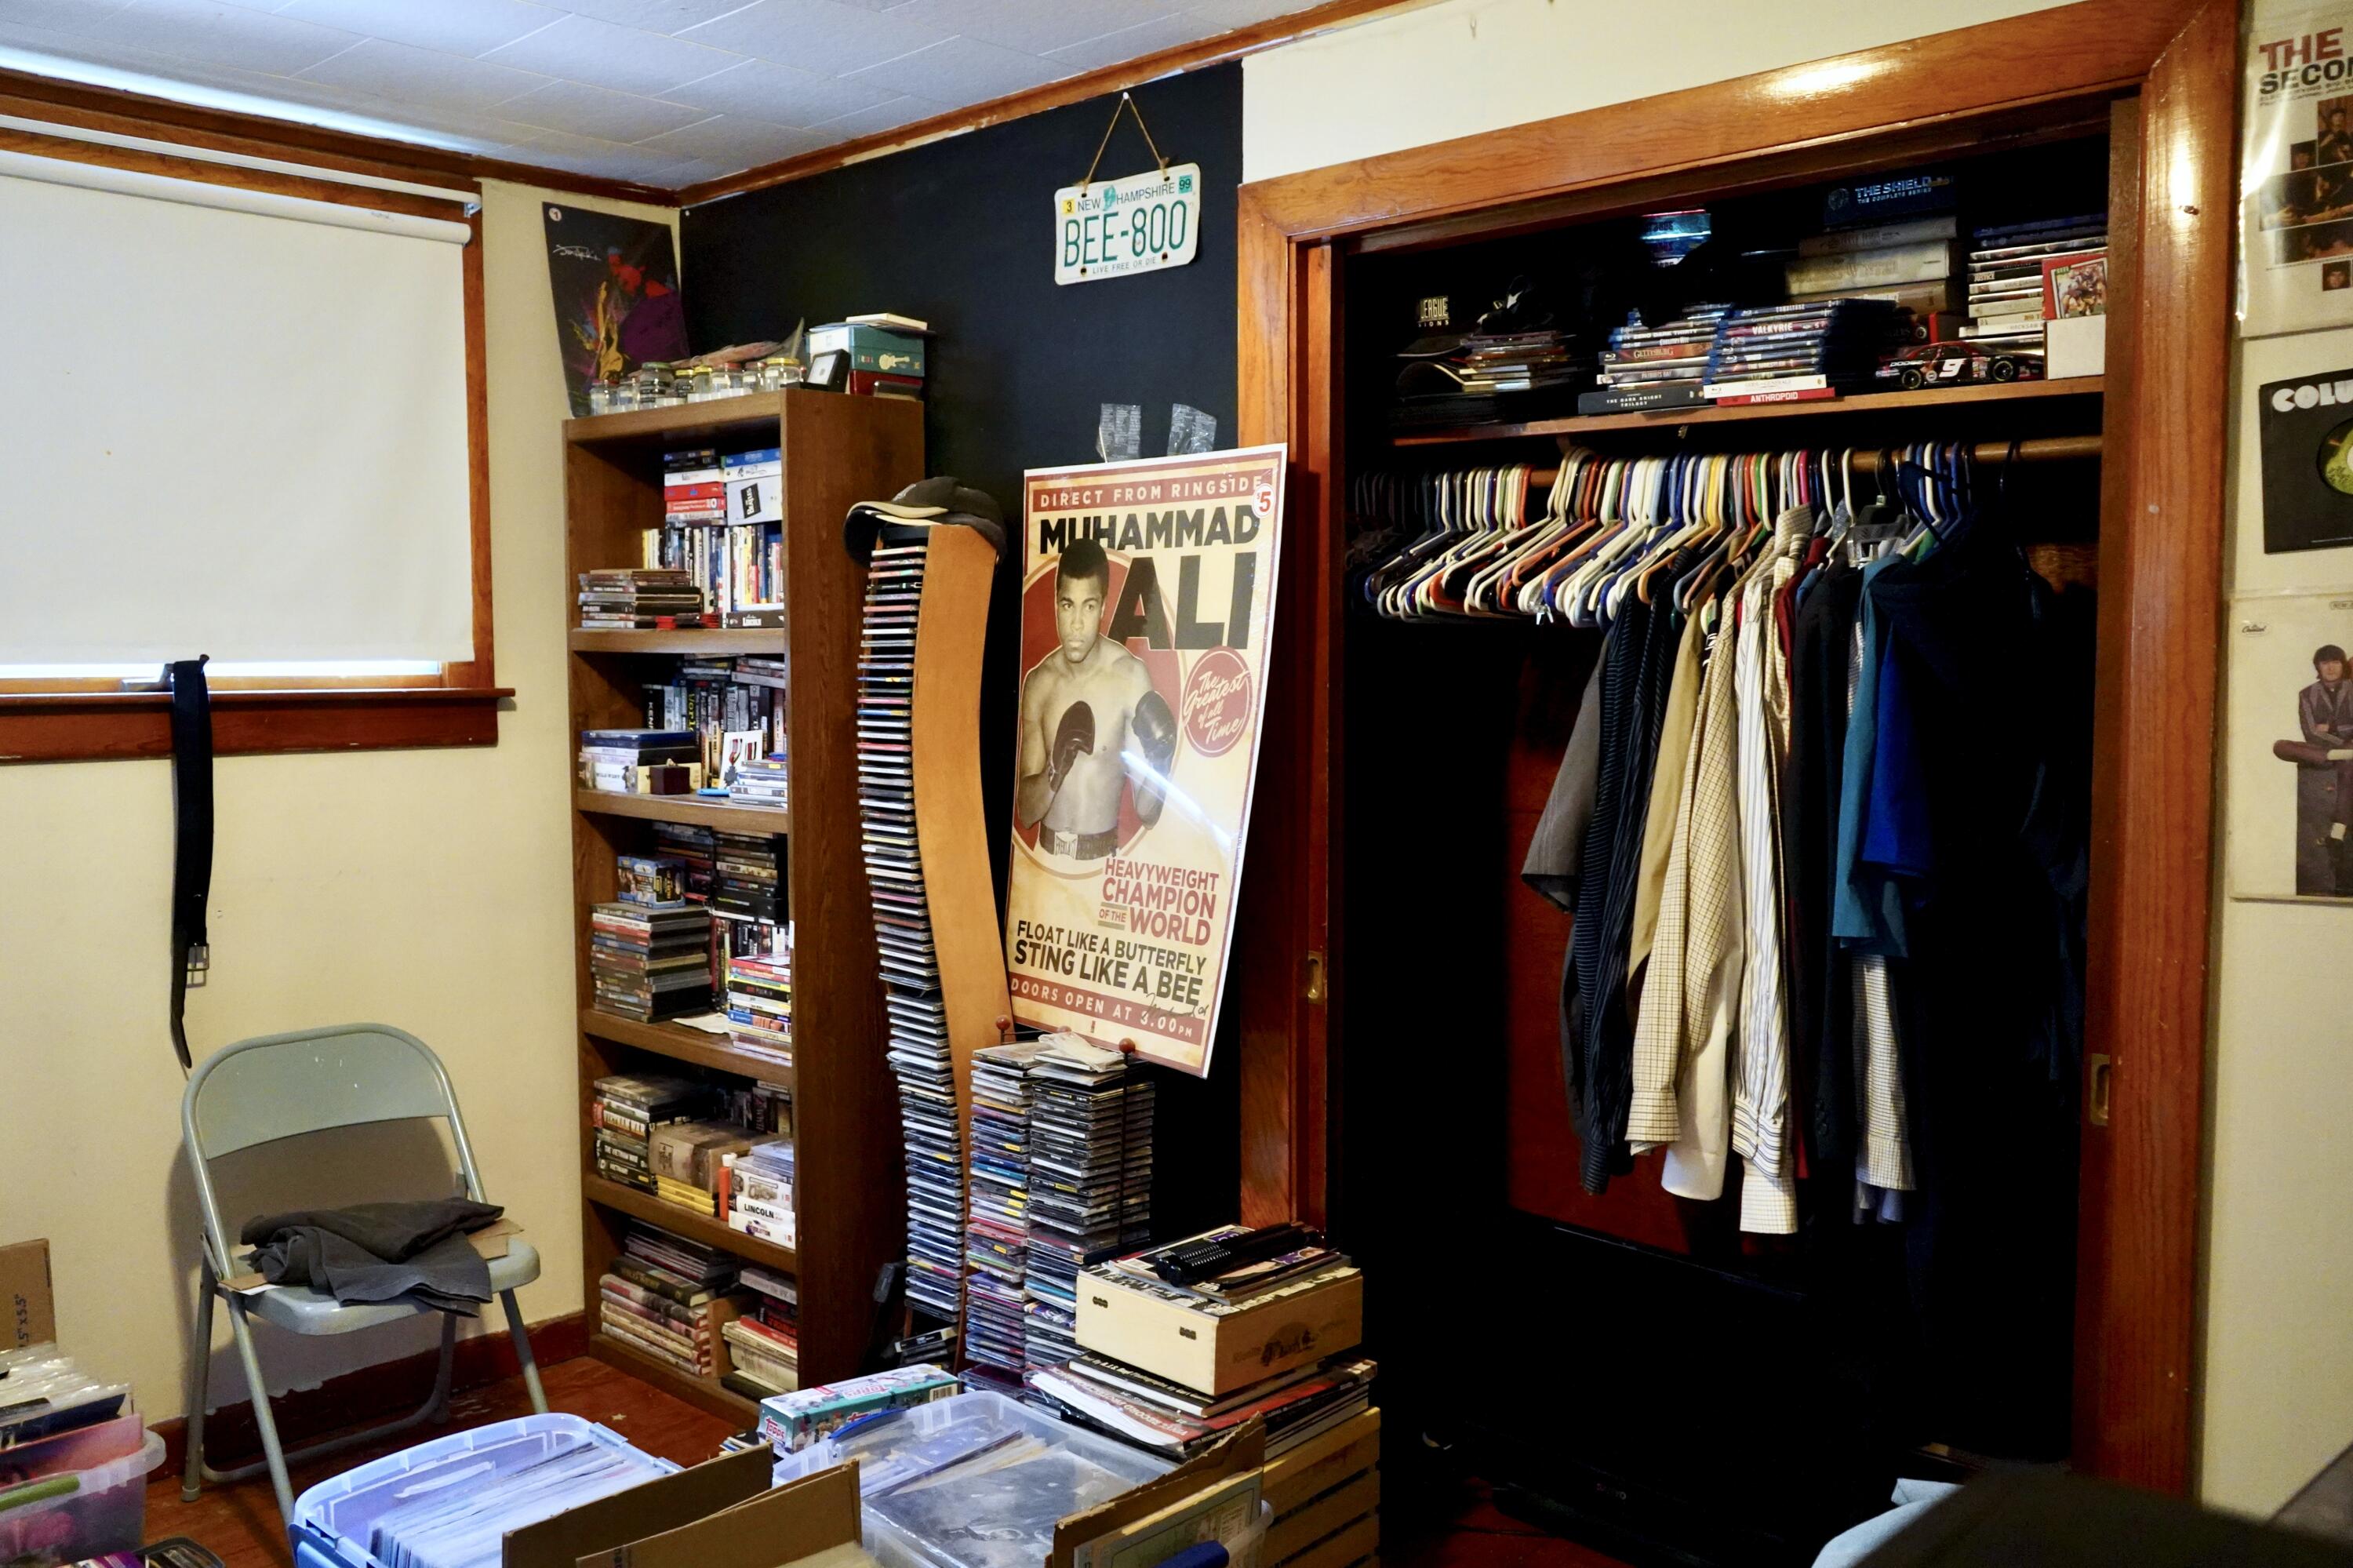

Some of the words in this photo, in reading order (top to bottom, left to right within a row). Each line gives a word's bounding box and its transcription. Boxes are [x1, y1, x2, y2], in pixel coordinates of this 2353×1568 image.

[2259, 27, 2344, 71] THE
[2259, 56, 2353, 94] SECO
[1067, 201, 1072, 213] 3
[1078, 198, 1100, 212] NEW
[1116, 183, 1175, 205] HAMPSHIRE
[1179, 178, 1191, 190] 99
[1855, 185, 1881, 198] THE
[1882, 176, 1933, 195] SHIELD
[1064, 200, 1187, 267] BEE-800
[1093, 265, 1109, 275] LIVE
[1112, 262, 1130, 271] FREE
[1146, 256, 1157, 266] DIE
[1752, 322, 1794, 335] VALKYRIE
[1939, 358, 1967, 377] 9
[1751, 391, 1798, 403] ANTHROPOID
[1041, 489, 1104, 508] DIRECT
[1114, 485, 1162, 503] FROM
[1172, 475, 1263, 498] RINGSIDE
[1040, 504, 1260, 555] MUHAMMAD
[1107, 551, 1257, 650] ALI
[1184, 670, 1253, 722] Greatest
[1199, 670, 1220, 692] The
[1207, 700, 1224, 720] all
[1205, 715, 1244, 744] Time
[1104, 857, 1220, 892] HEAVYWEIGHT
[1099, 908, 1110, 919] OF
[1111, 910, 1127, 922] THE
[1102, 877, 1217, 919] CHAMPION
[1129, 907, 1212, 947] WORLD
[1017, 920, 1064, 944] FLOAT
[1067, 930, 1098, 953] LIKE
[1100, 937, 1110, 955] A
[1115, 940, 1207, 975] BUTTERFLY
[1014, 939, 1075, 976] STING
[1079, 954, 1129, 988] LIKE
[1132, 966, 1148, 994] A
[1156, 971, 1203, 1006] BEE
[1010, 978, 1058, 1002] DOORS
[1065, 993, 1104, 1014] OPEN
[1112, 1003, 1132, 1020] AT
[744, 1203, 774, 1219] LINCOLN
